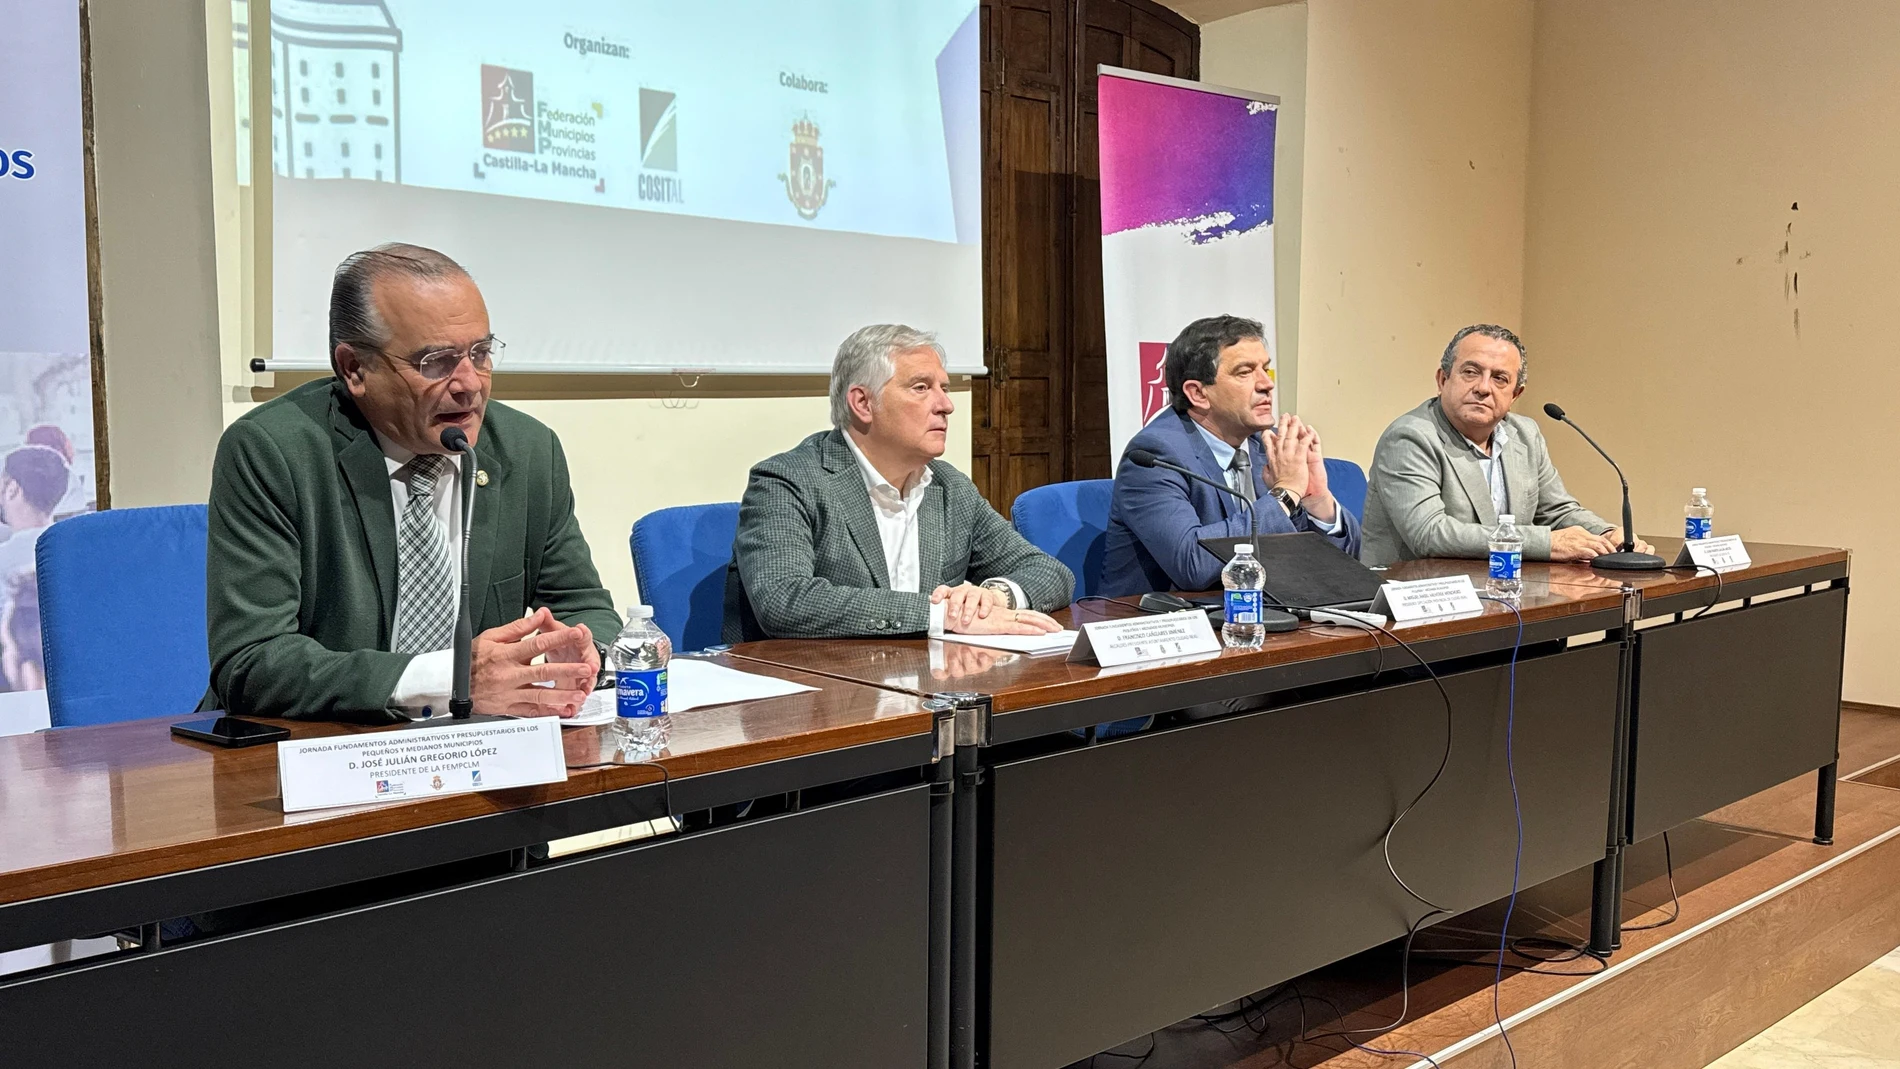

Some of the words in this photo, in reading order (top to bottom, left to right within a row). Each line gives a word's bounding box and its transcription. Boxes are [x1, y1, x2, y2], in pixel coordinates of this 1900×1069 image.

[563, 31, 630, 59] Organizan:
[779, 71, 829, 94] Colabora:
[537, 100, 596, 127] Federación
[538, 119, 596, 144] Municipios
[538, 137, 597, 161] Provincias
[483, 153, 549, 175] Castilla-La
[551, 161, 597, 180] Mancha
[638, 172, 685, 204] COSITAL
[299, 745, 333, 755] JORNADA
[334, 740, 387, 751] FUNDAMENTOS
[388, 734, 450, 746] ADMINISTRATIVOS
[456, 728, 516, 739] PRESUPUESTARIOS
[362, 746, 399, 757] PEQUEÑOS
[406, 743, 443, 753] MEDIANOS
[444, 739, 483, 749] MUNICIPIOS
[348, 762, 360, 770] D.
[361, 758, 383, 769] JOSÉ
[385, 755, 418, 767] JULIÁN
[419, 750, 468, 763] GREGORIO
[470, 747, 498, 758] LÓPEZ
[369, 768, 417, 779] PRESIDENTE
[418, 766, 430, 774] DE
[431, 764, 441, 773] LA
[442, 761, 480, 772] FEMPCLM
